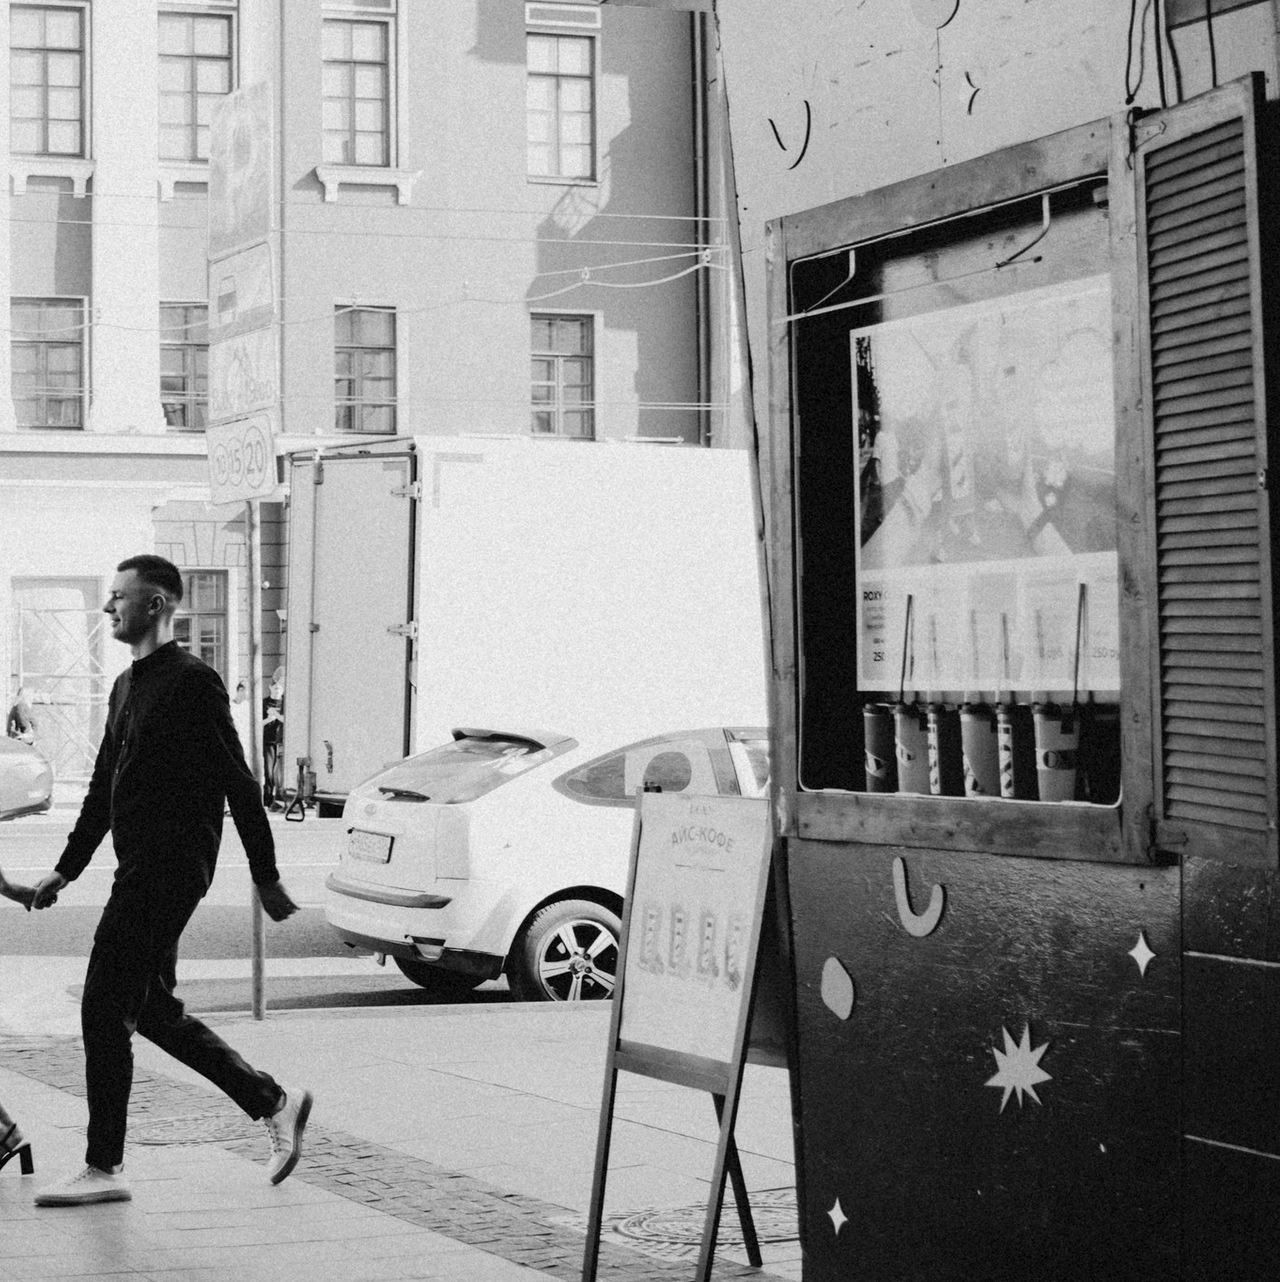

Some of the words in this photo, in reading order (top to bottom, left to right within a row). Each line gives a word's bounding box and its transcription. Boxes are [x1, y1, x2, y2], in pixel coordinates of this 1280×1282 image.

[229, 448, 241, 474] 15
[245, 439, 264, 475] 20
[671, 824, 736, 854] АЙС-КОФЕ
